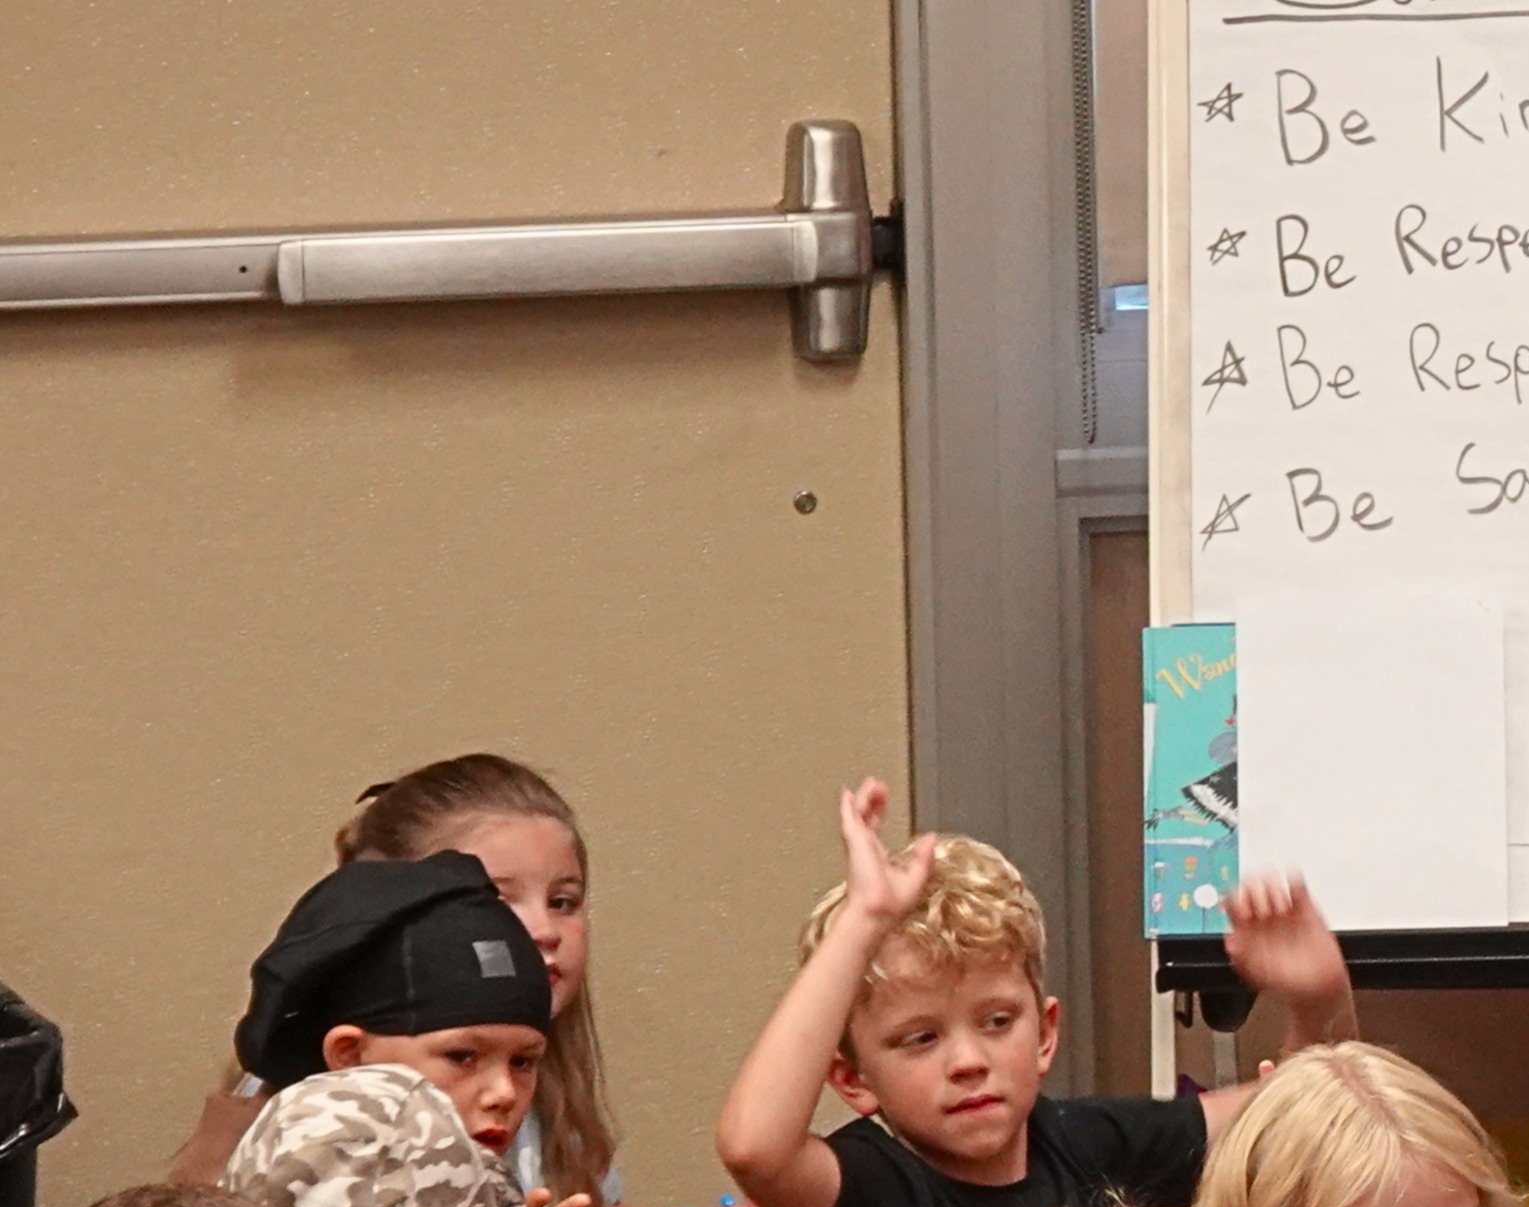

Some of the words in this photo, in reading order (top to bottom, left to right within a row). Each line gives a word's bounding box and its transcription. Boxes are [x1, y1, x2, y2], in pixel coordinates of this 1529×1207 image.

[1277, 70, 1375, 165] Be
[1277, 215, 1355, 297] Be
[1278, 325, 1358, 409] Be
[1287, 469, 1392, 540] Be
